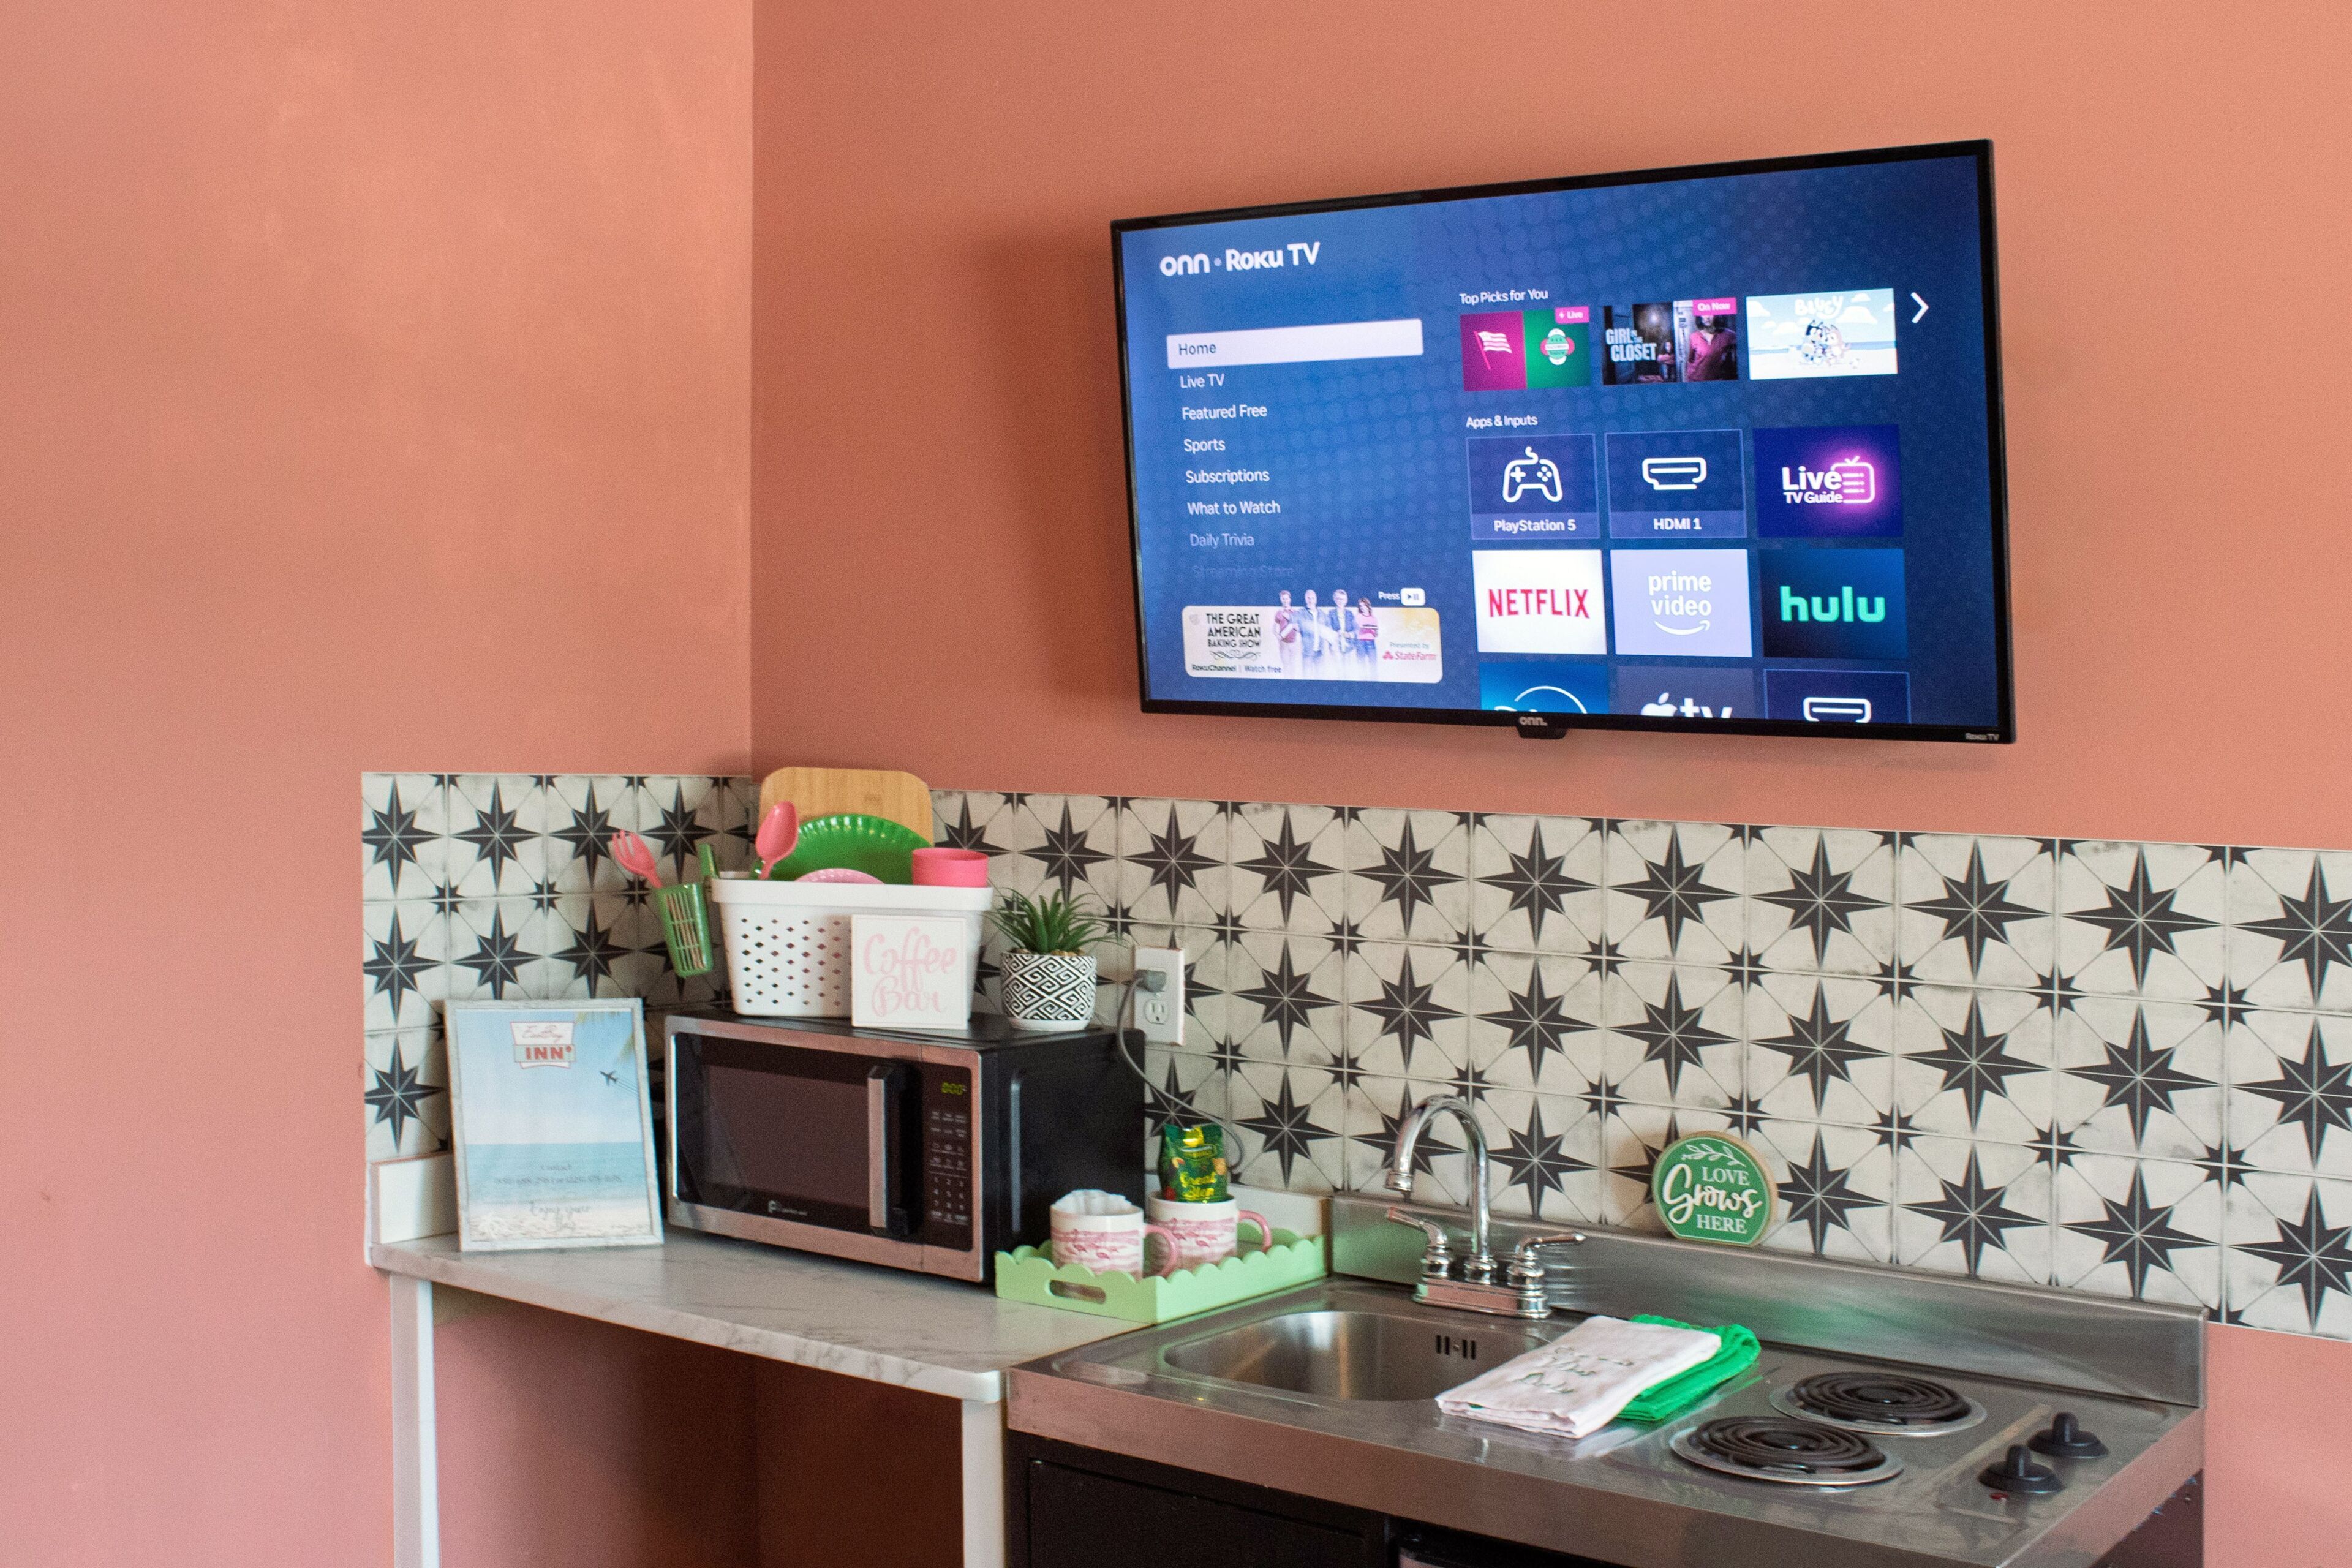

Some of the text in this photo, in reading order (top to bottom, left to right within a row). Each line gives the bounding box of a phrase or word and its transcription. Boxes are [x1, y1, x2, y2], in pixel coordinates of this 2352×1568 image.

[1160, 253, 1210, 277] onn
[1287, 241, 1320, 266] TV
[1460, 288, 1548, 306] Top Picks for You
[1697, 301, 1731, 311] On Now
[1566, 311, 1583, 319] Live
[1605, 328, 1634, 345] GIRL
[1178, 343, 1216, 356] Home
[1611, 343, 1657, 361] CLOSET
[1180, 374, 1225, 389] Live TV
[1182, 404, 1267, 420] Featured Free
[1466, 415, 1537, 429] Apps & Inputs
[1183, 438, 1226, 454] Sports
[1186, 469, 1270, 484] Subscriptions
[1782, 466, 1842, 491] Live
[1783, 491, 1843, 503] TV Guide
[1187, 500, 1281, 515] What to Watch
[1493, 519, 1576, 534] PlayStation 5
[1654, 518, 1702, 530] HDMI 1
[1190, 533, 1254, 549] Daily Trivia
[1648, 570, 1711, 595] prime
[1378, 591, 1400, 600] Press
[1488, 589, 1590, 619] NETFLIX
[1651, 595, 1711, 616] video
[1780, 586, 1886, 623] hulu
[1206, 613, 1259, 624] THE GREAT
[1208, 627, 1261, 637] AMERICAN
[1208, 639, 1237, 647] BAKING
[863, 926, 958, 993] Coffee
[872, 975, 943, 1017] Bar
[526, 1047, 564, 1060] INN
[1702, 1166, 1751, 1186] LOVE
[1662, 1163, 1763, 1224] Grows
[1696, 1214, 1747, 1234] HERE
